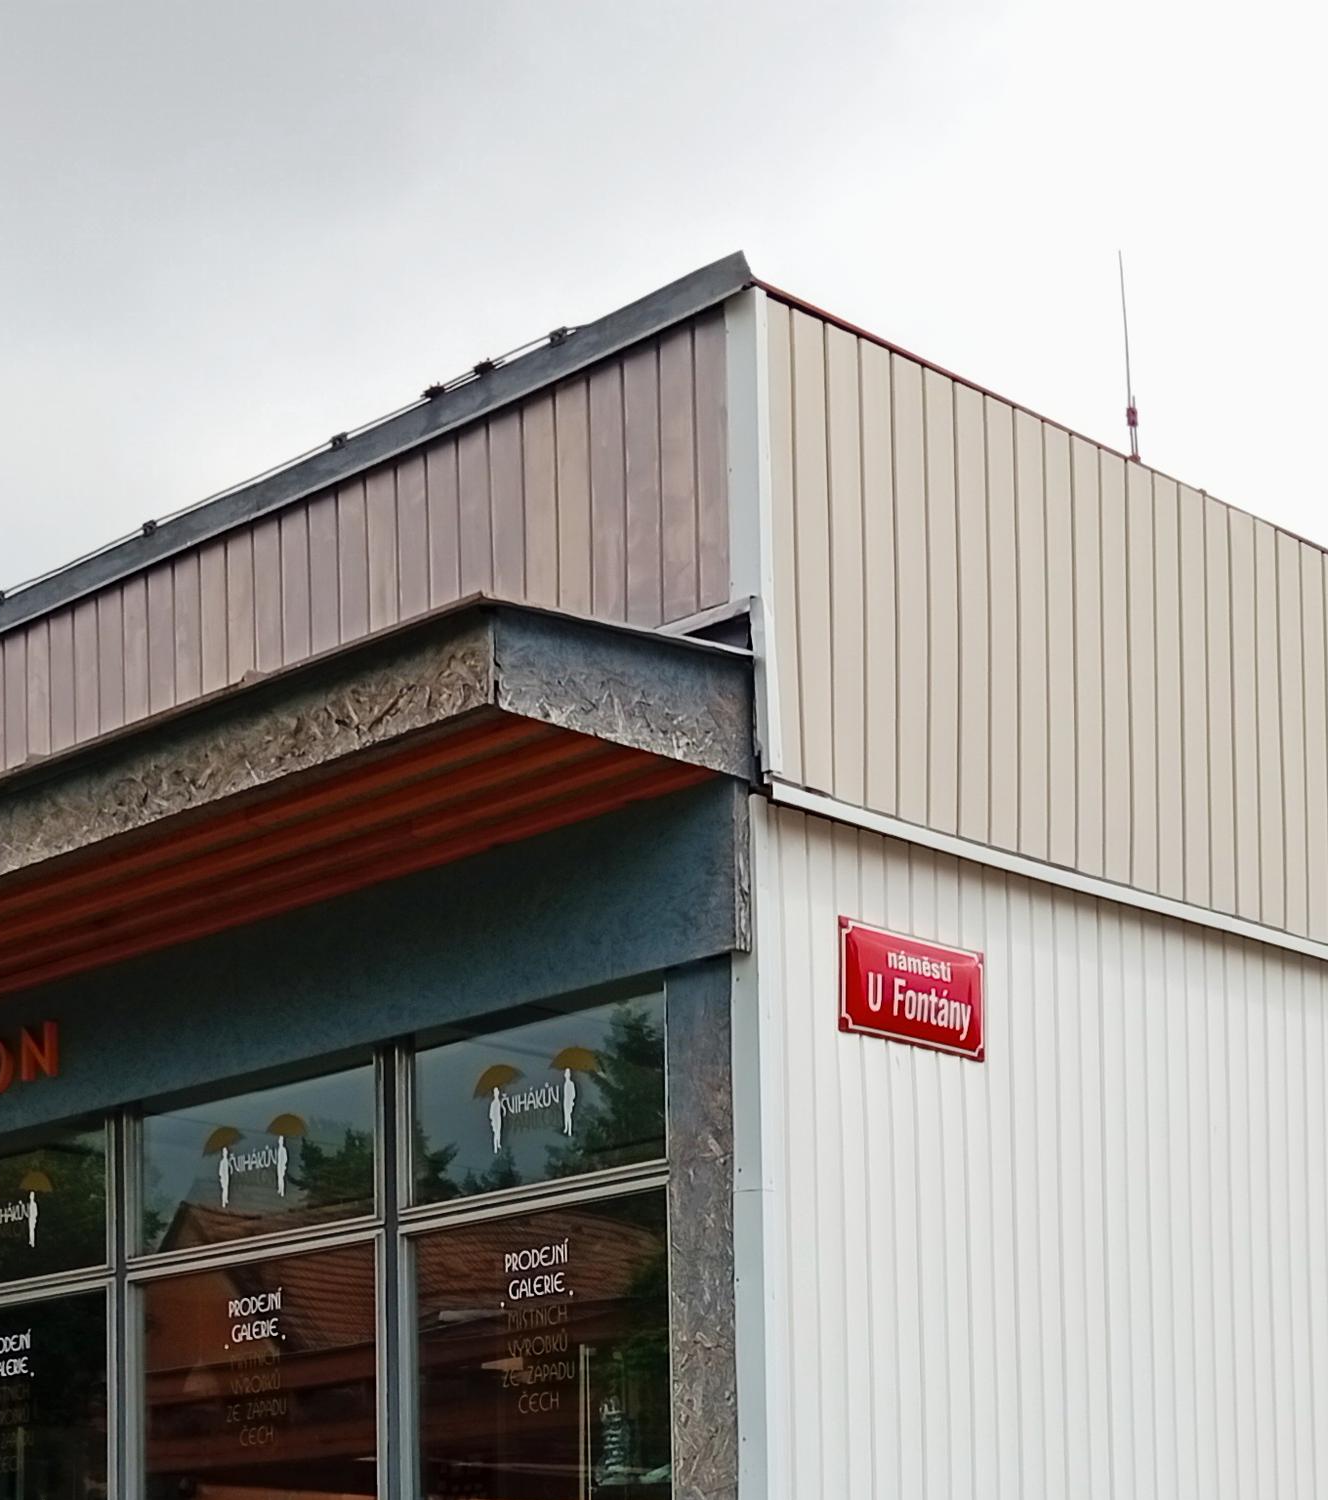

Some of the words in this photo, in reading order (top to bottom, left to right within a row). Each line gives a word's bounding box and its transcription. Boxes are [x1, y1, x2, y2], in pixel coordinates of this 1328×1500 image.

[887, 950, 952, 983] náměstí
[868, 971, 883, 1013] U
[893, 976, 971, 1041] Fontány
[504, 1237, 569, 1273] PRODEJNÍ
[508, 1272, 566, 1301] GALERIE
